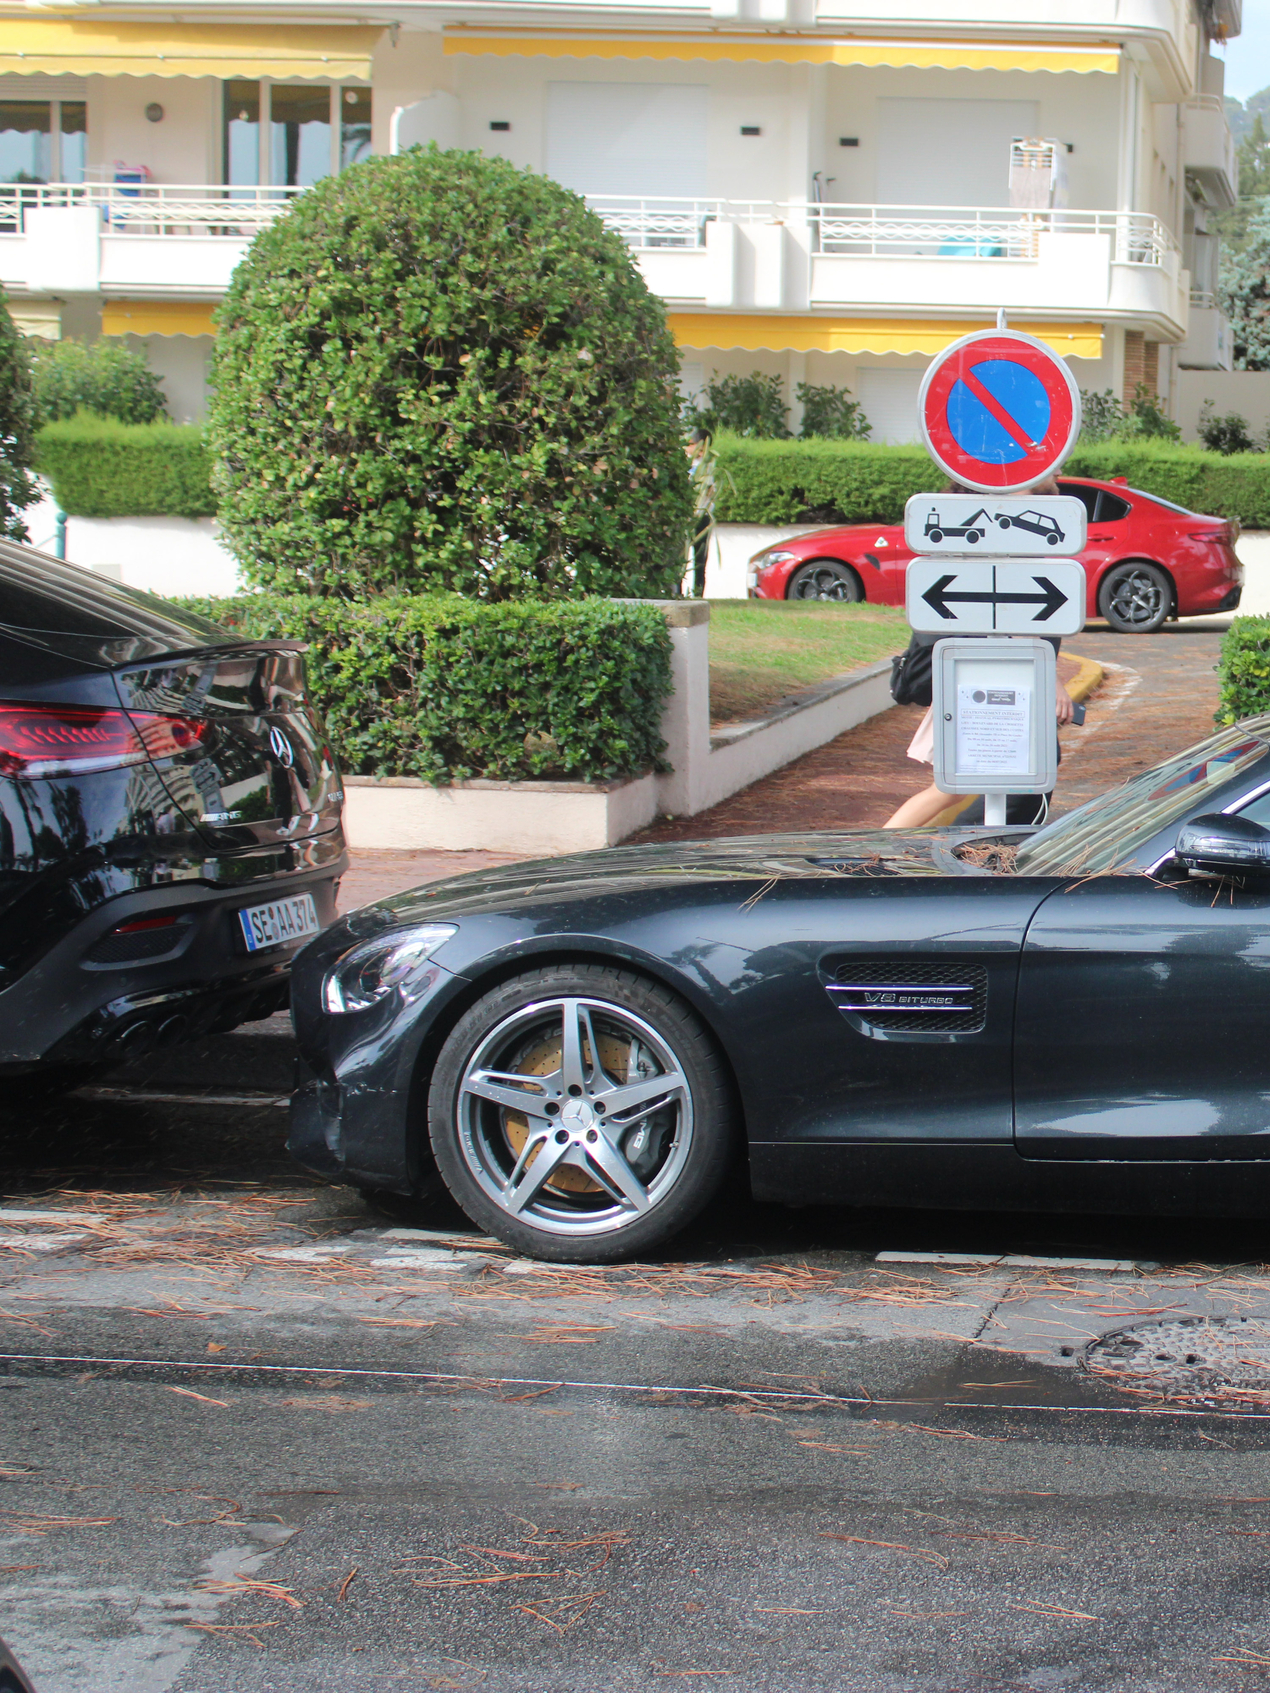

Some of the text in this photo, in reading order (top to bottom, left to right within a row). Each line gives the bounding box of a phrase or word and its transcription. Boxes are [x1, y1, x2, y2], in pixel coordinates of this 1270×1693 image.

[251, 898, 317, 943] SE AA 374
[864, 992, 954, 1005] V8 BITURBO
